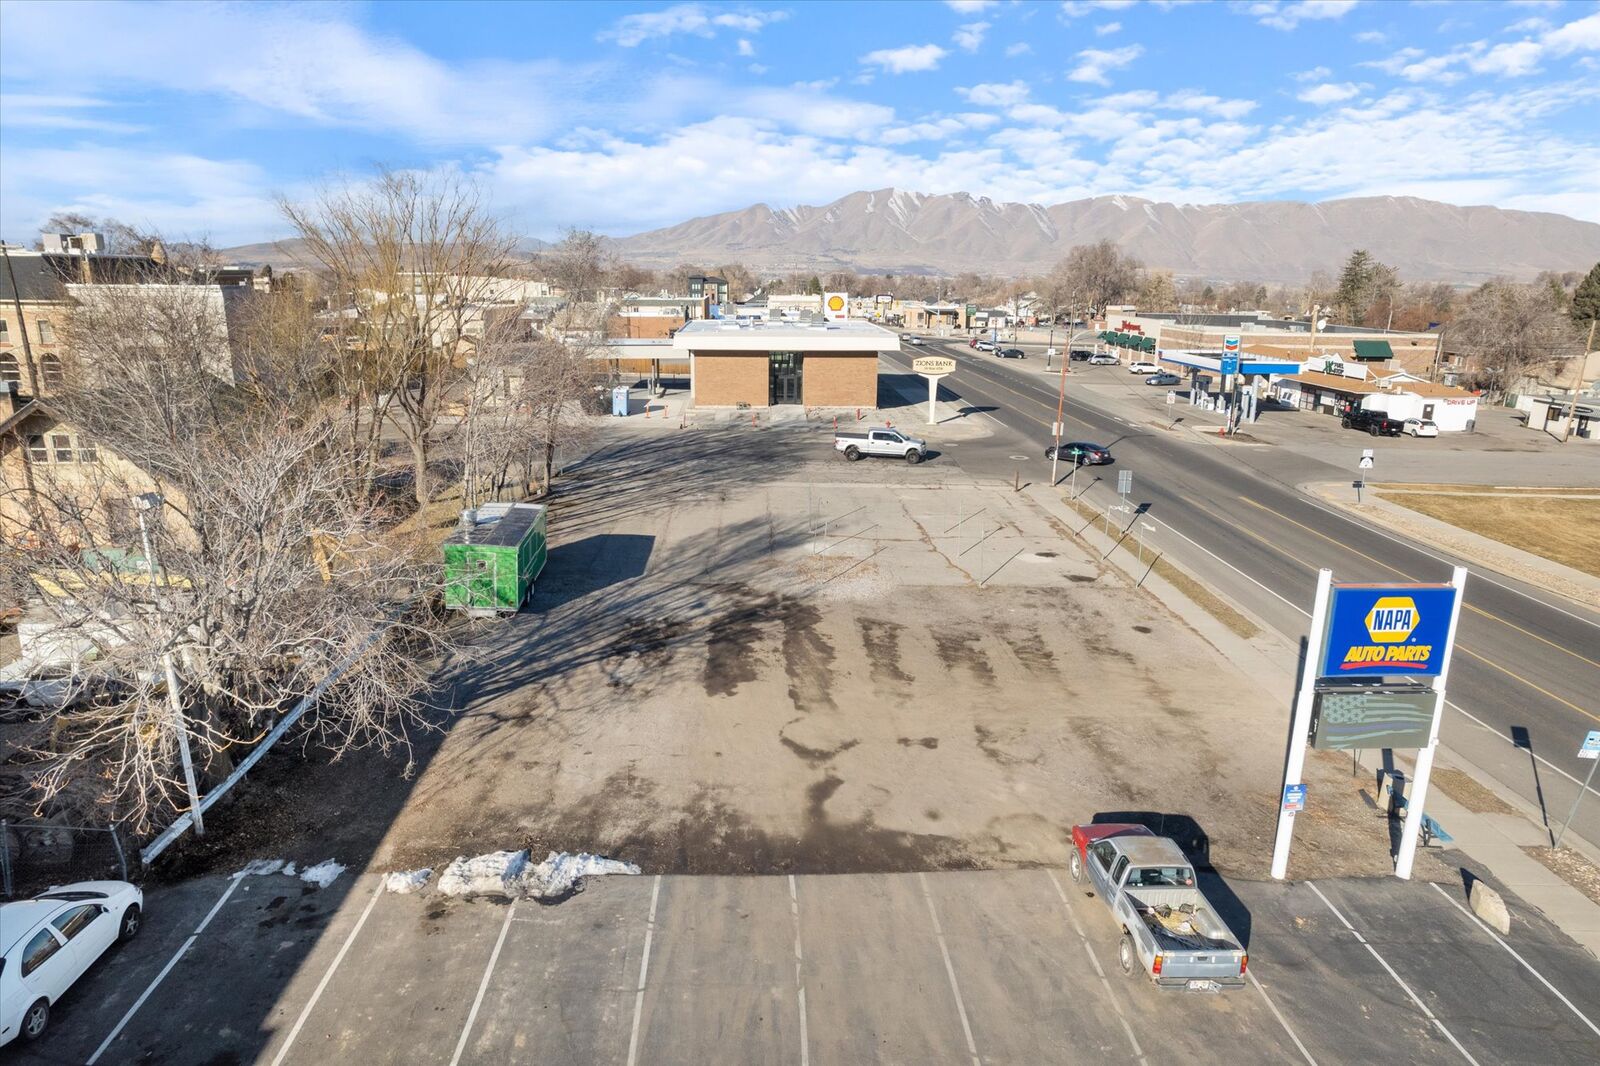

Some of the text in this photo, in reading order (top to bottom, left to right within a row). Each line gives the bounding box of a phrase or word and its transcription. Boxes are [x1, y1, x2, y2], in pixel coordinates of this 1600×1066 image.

[1373, 609, 1411, 630] NAPA
[1343, 645, 1432, 662] AUTO PARTS
